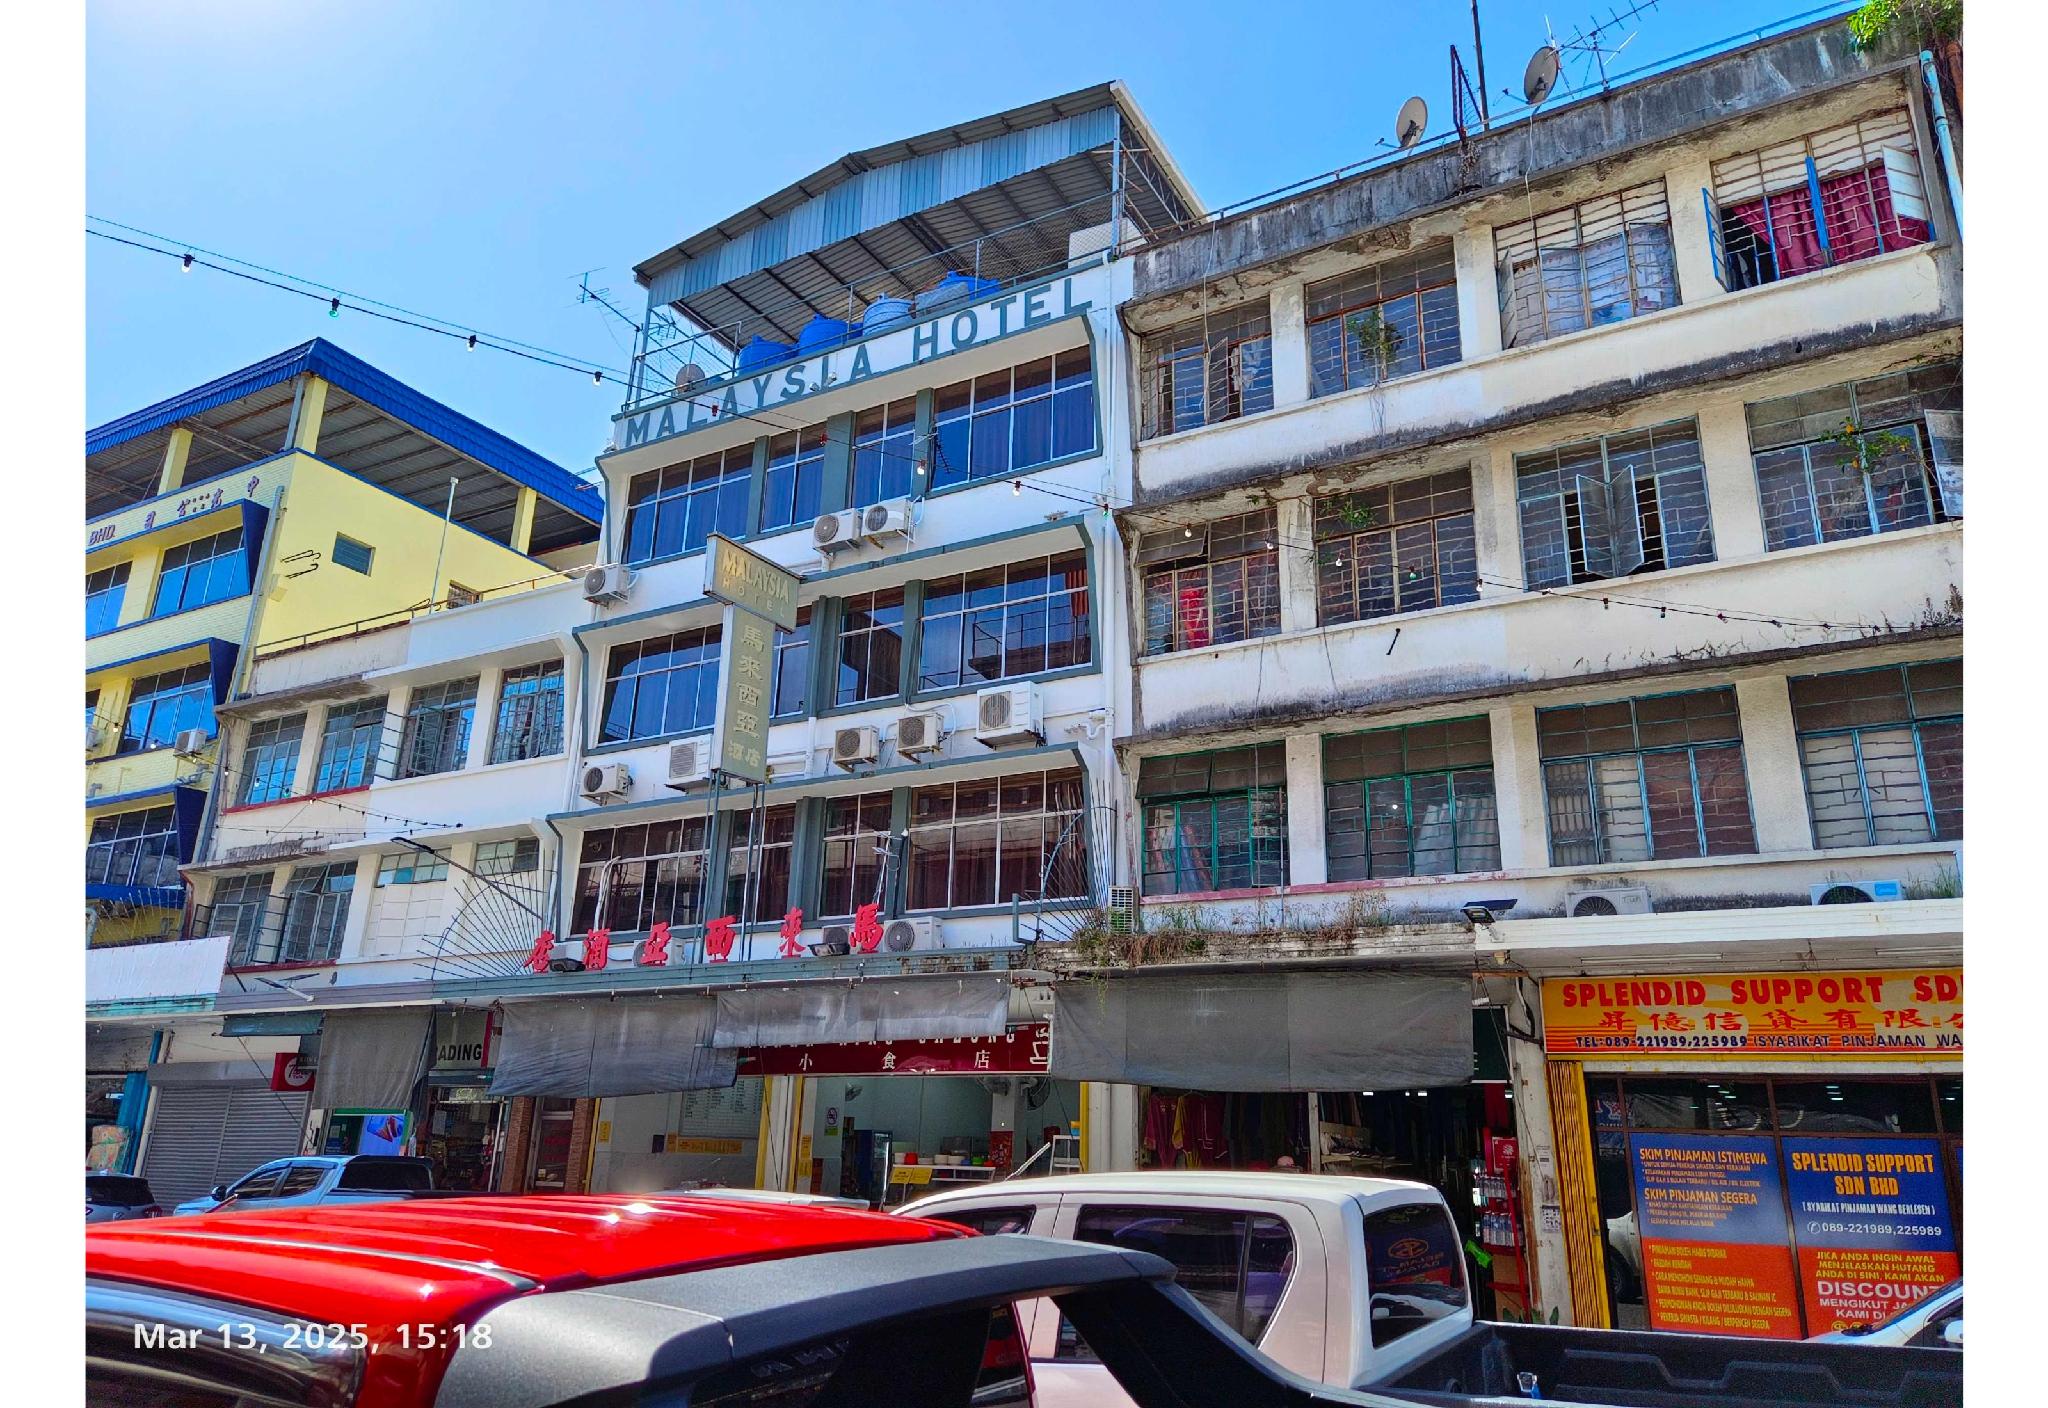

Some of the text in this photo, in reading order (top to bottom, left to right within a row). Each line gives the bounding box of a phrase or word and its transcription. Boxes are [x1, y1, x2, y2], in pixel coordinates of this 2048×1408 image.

[626, 277, 1093, 447] MALAYSIA HOTEL
[722, 549, 789, 606] MALAYSIA
[722, 577, 785, 618] HOTEL
[1563, 981, 1706, 1008] SPLENDID
[1731, 977, 1884, 1005] SUPPORT
[1842, 1034, 1926, 1047] PINJAMAN
[1640, 1148, 1768, 1165] SKIM PINJAMAN ISTIMEWA
[1792, 1152, 1934, 1173] SPLENDID SUPPORT
[1835, 1176, 1899, 1196] SDN BHD
[1645, 1187, 1758, 1206] SKIM PINJAMAN SEGERA
[1841, 1203, 1876, 1214] PINJAMAN
[1876, 1204, 1897, 1214] WANG
[1822, 1222, 1942, 1236] 089-221989,225989
[1816, 1251, 1936, 1264] JIKA ANDA INGIN AWAL
[1819, 1261, 1936, 1273] MENJELASKAN HUTANG
[1816, 1270, 1844, 1278] ANDA
[1885, 1273, 1911, 1281] KAMI
[1914, 1274, 1945, 1283] AKAN
[1820, 1299, 1889, 1309] MENGIKUT
[1836, 1309, 1870, 1319] KAMI
